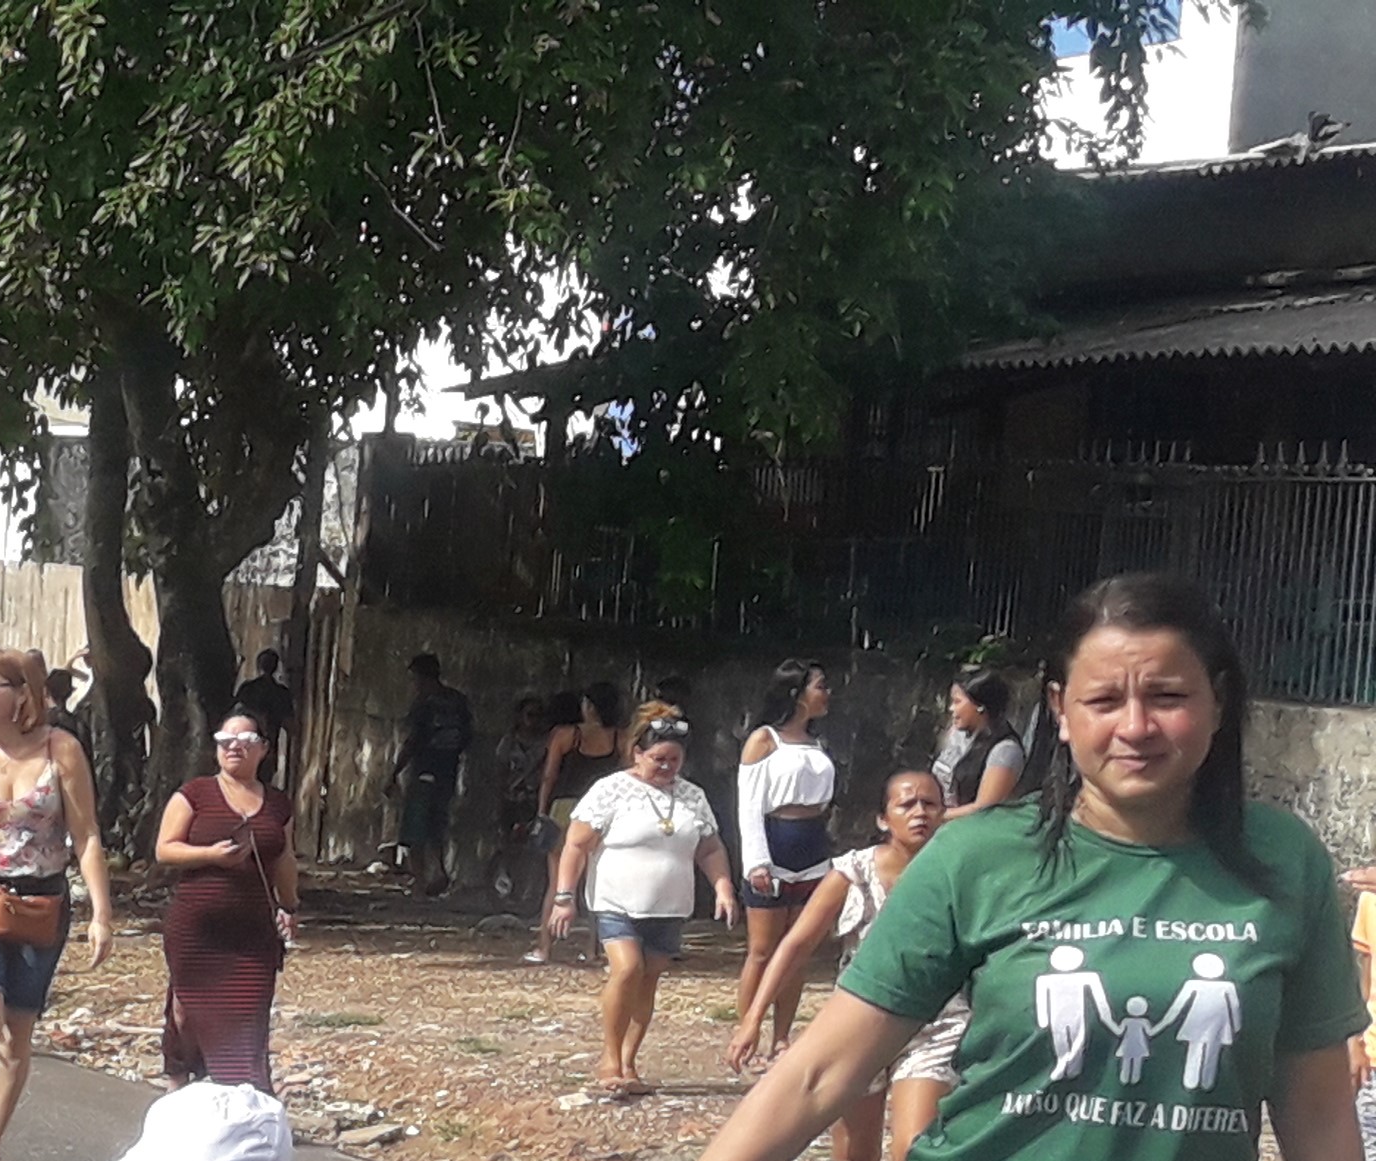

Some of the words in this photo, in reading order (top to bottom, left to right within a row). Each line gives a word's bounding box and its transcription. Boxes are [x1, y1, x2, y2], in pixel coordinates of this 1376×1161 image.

[1132, 916, 1147, 938] E
[1155, 919, 1258, 942] ESCOLA
[1066, 1092, 1106, 1124] QUE
[1109, 1101, 1147, 1127] FAZ
[1151, 1103, 1165, 1129] A
